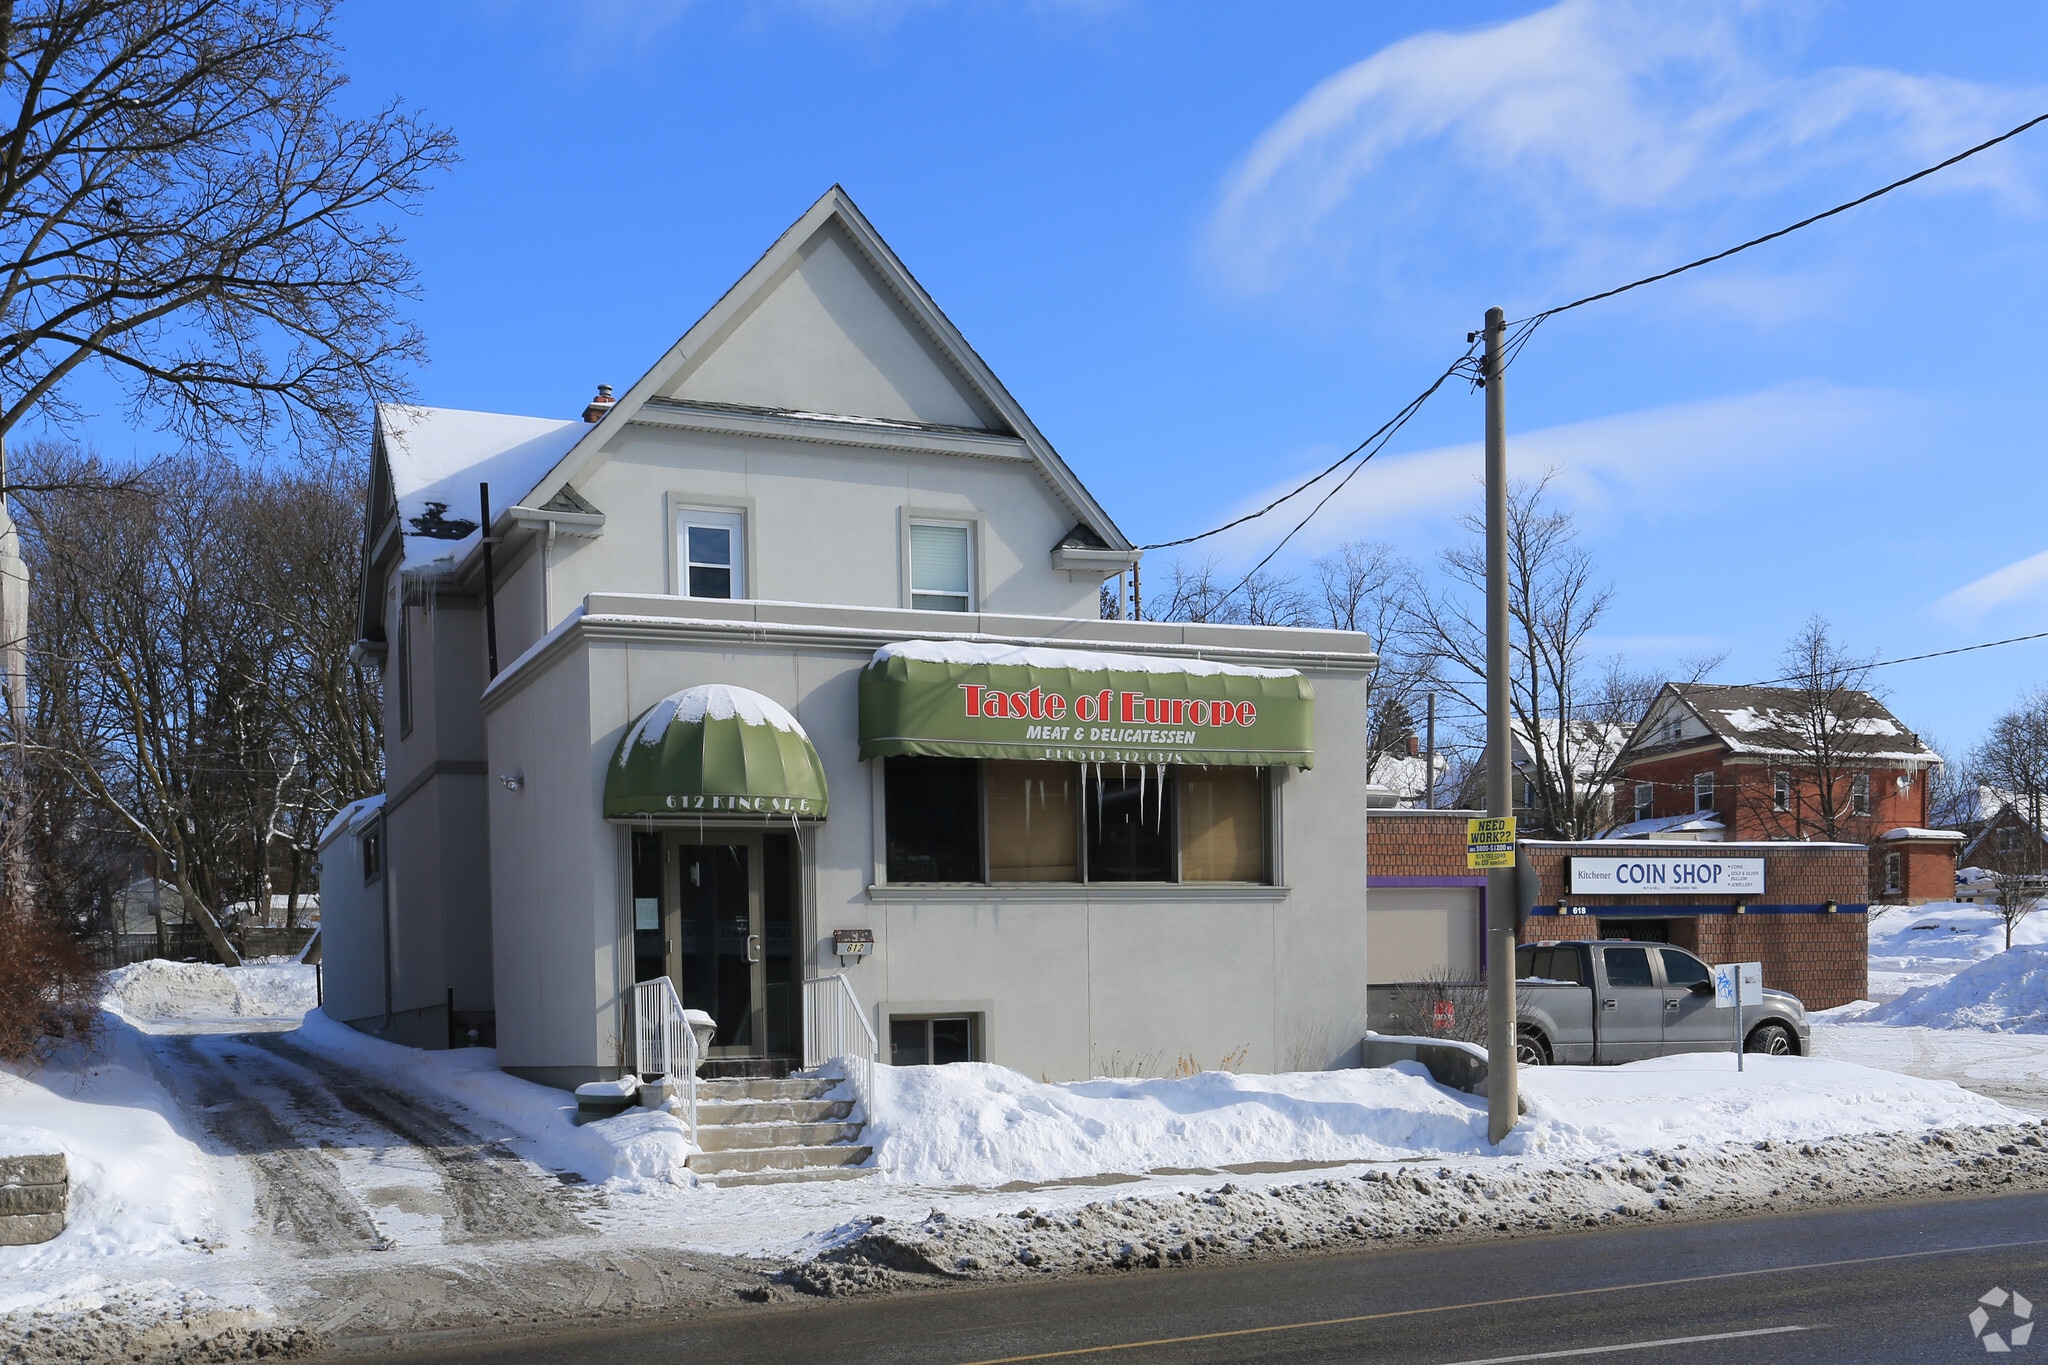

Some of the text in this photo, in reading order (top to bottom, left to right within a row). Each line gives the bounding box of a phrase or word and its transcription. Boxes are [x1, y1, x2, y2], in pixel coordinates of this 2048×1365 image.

[958, 684, 1256, 727] Taste of Europe
[1026, 725, 1195, 744] MEAT & DELICATESSEN
[666, 795, 705, 809] 612
[712, 796, 765, 810] KING
[771, 797, 795, 811] ST.
[1478, 820, 1505, 831] NEED
[1471, 831, 1511, 843] WORK??
[1578, 864, 1722, 884] Kitchener COIN SHOP
[1573, 906, 1587, 915] 618
[846, 943, 865, 953] 612
